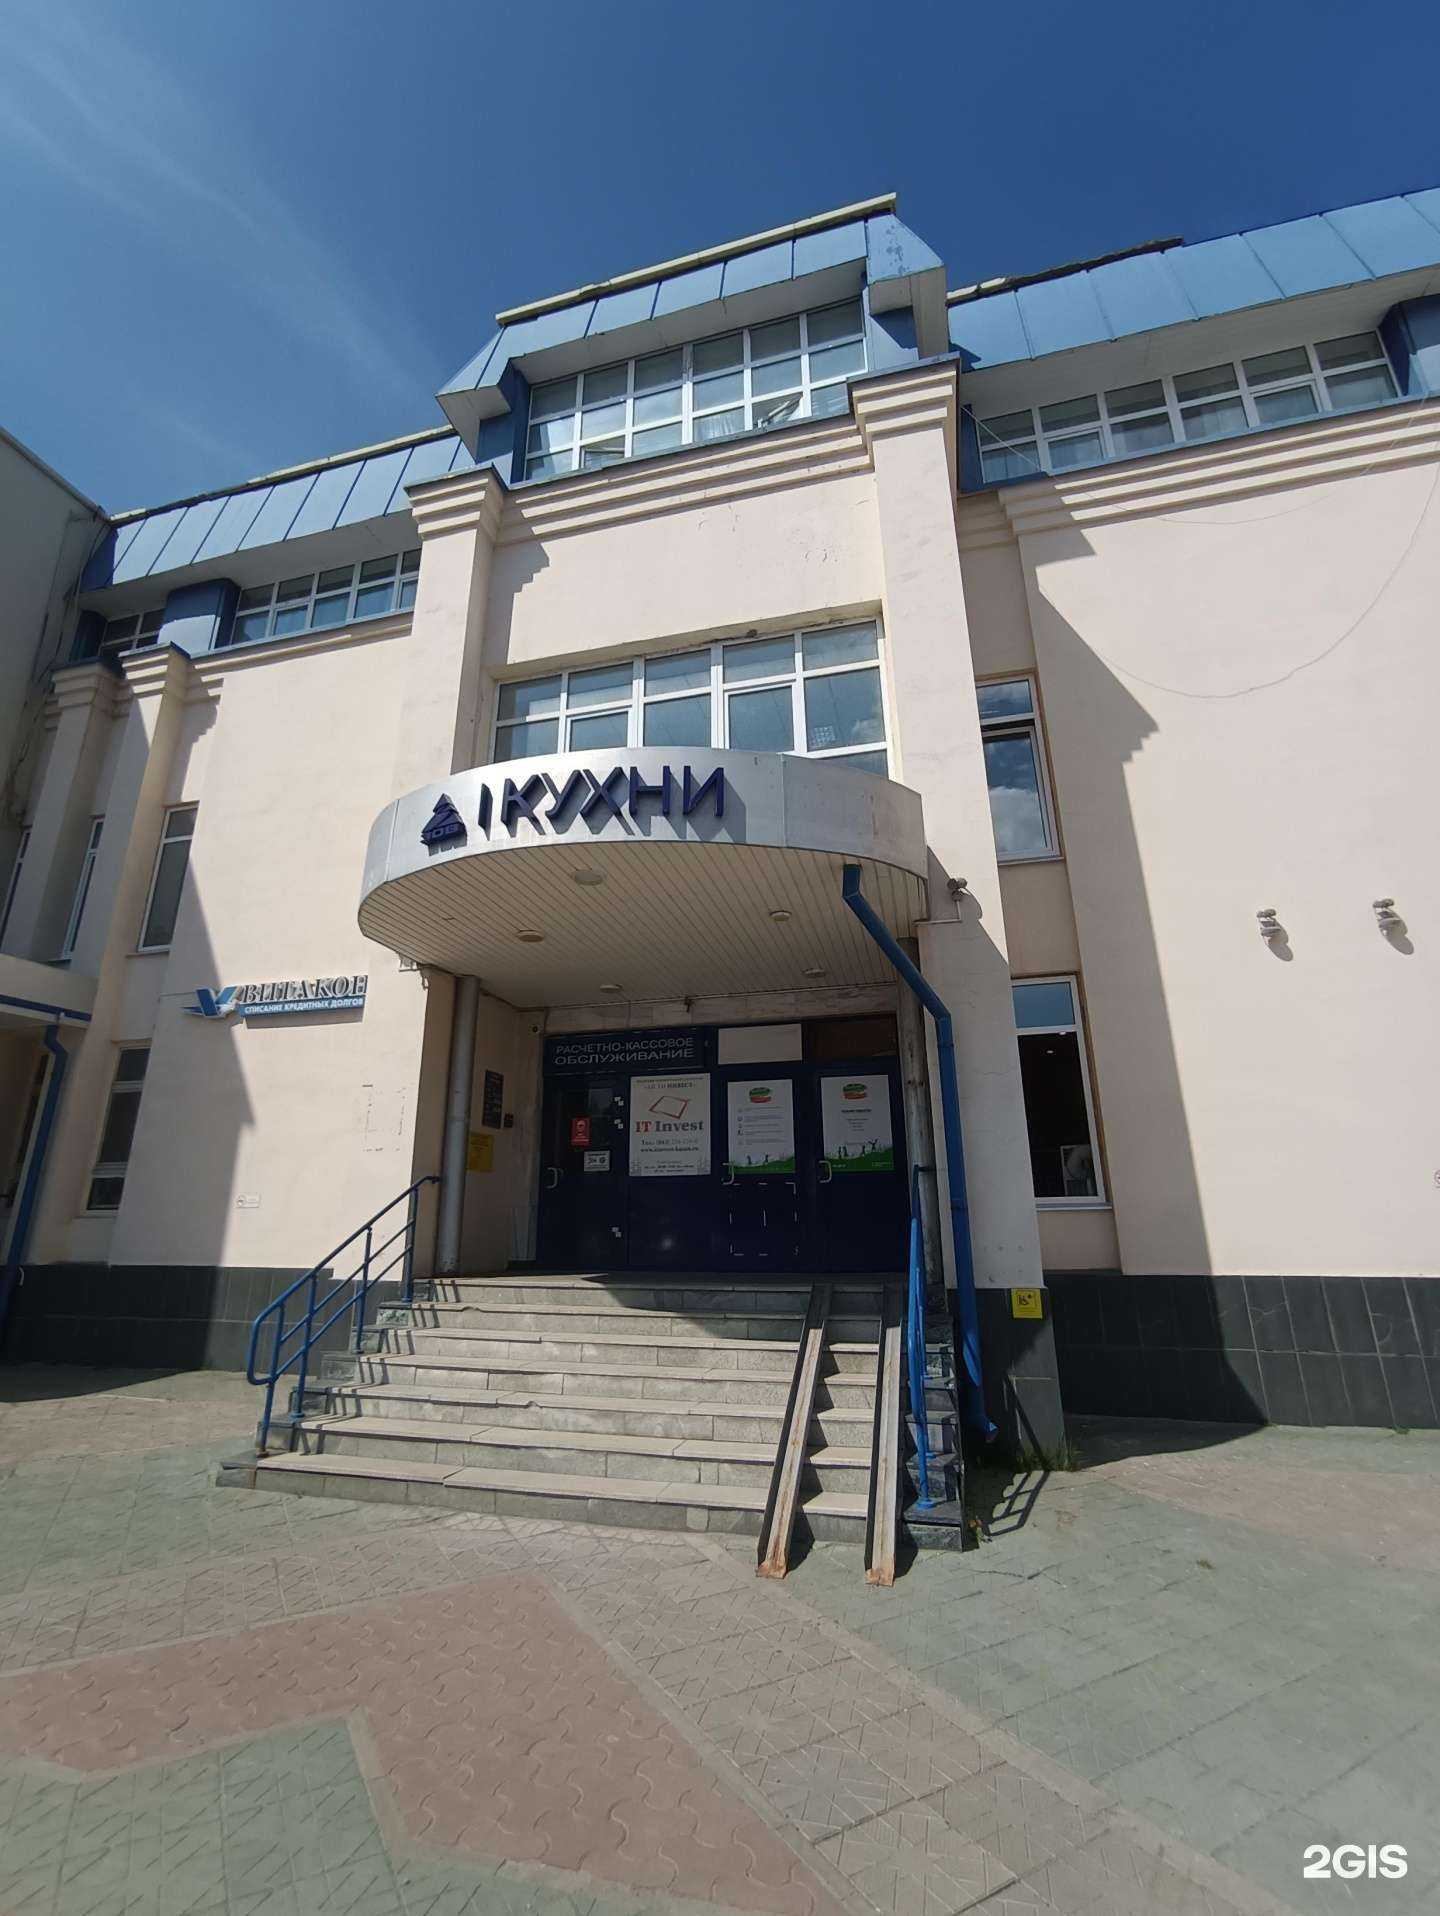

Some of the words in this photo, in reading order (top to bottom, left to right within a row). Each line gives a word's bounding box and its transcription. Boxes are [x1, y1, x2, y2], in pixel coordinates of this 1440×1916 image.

[500, 765, 725, 834] КУХНИ
[242, 975, 368, 1003] ВИТАКОН
[244, 1003, 284, 1014] СПИСАНИЕ
[285, 1000, 329, 1012] КРЕДИТНЫХ
[330, 997, 364, 1009] ДОЛГОВ
[555, 1037, 695, 1055] РАСЧЕТНО-КАССОВОЕ
[554, 1048, 695, 1065] ОБСЛУЖИВАНИЕ
[635, 1120, 652, 1133] IT
[655, 1119, 704, 1132] Invest
